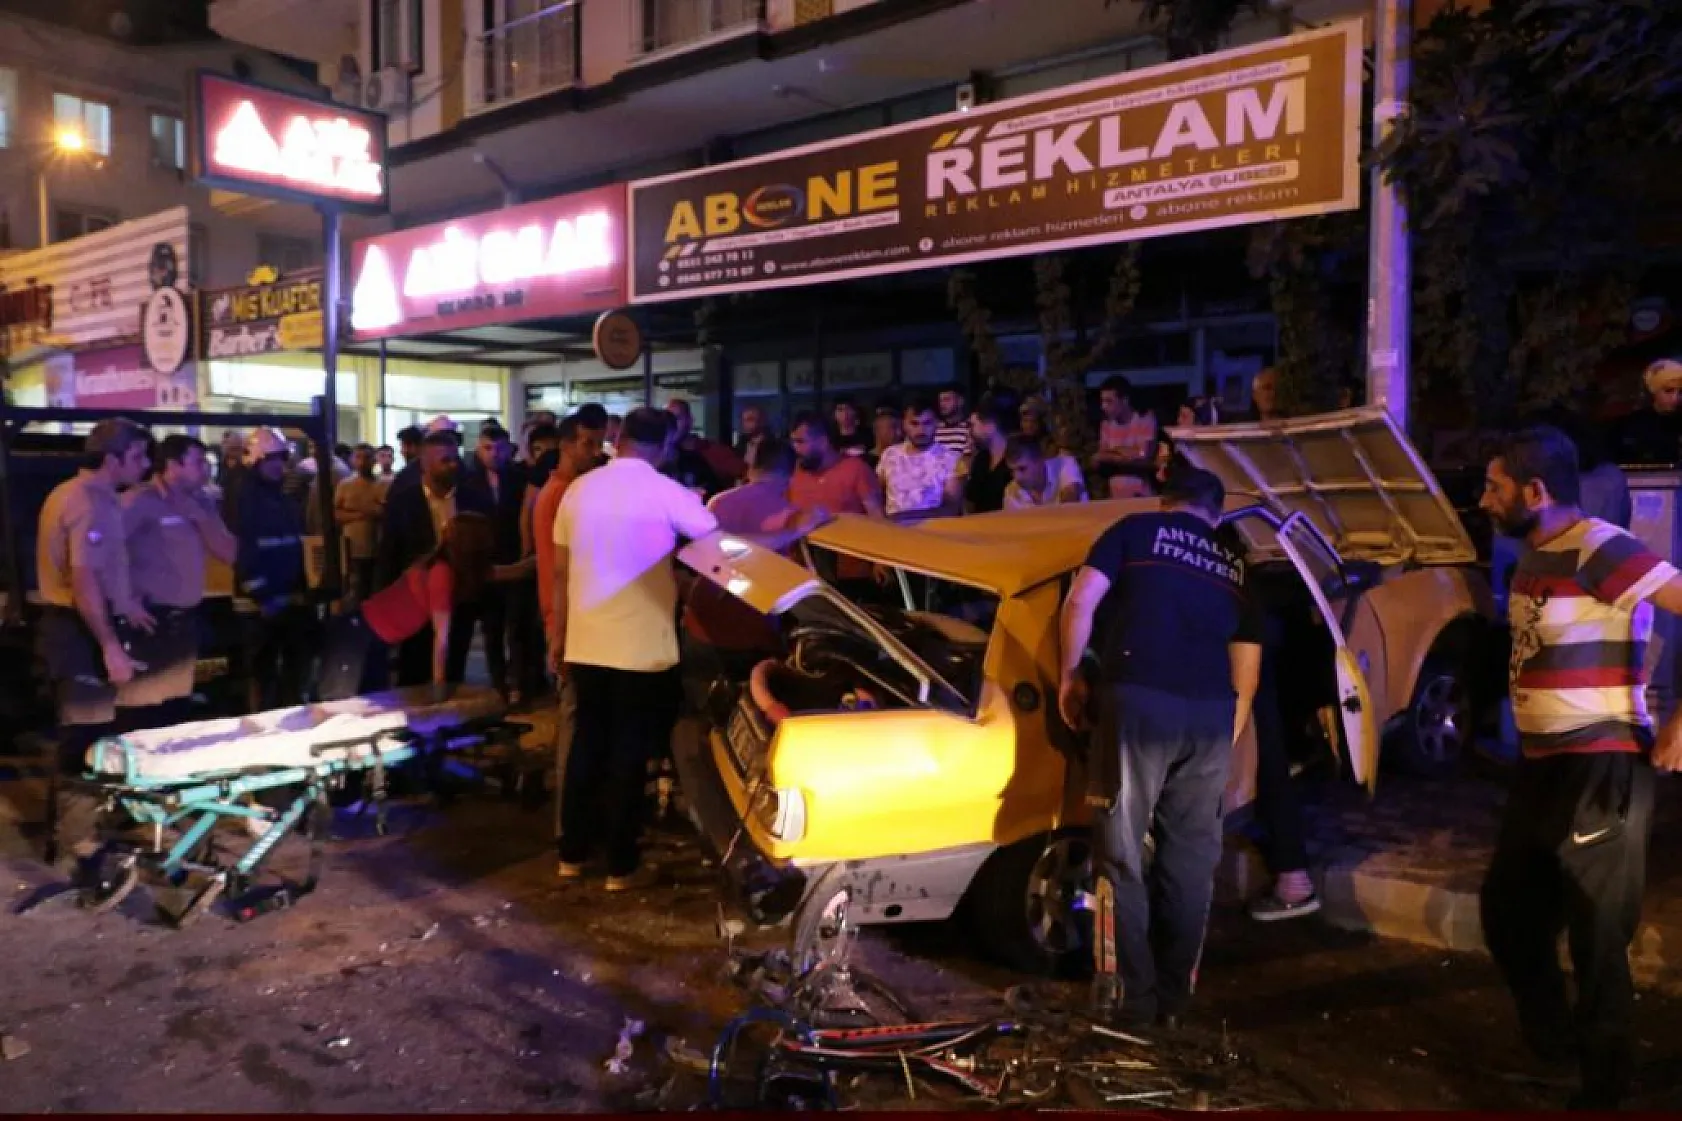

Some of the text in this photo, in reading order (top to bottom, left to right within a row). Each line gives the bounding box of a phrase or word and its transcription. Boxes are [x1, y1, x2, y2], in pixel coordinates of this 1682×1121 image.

[926, 76, 1307, 199] REKLAM
[665, 160, 899, 243] ABONE
[925, 185, 1048, 217] REKLAM
[1113, 180, 1205, 202] ANTALYA
[1156, 186, 1299, 217] abone reklam
[942, 232, 987, 249] abone
[990, 226, 1041, 242] reklam
[1157, 525, 1245, 574] ANTALYA
